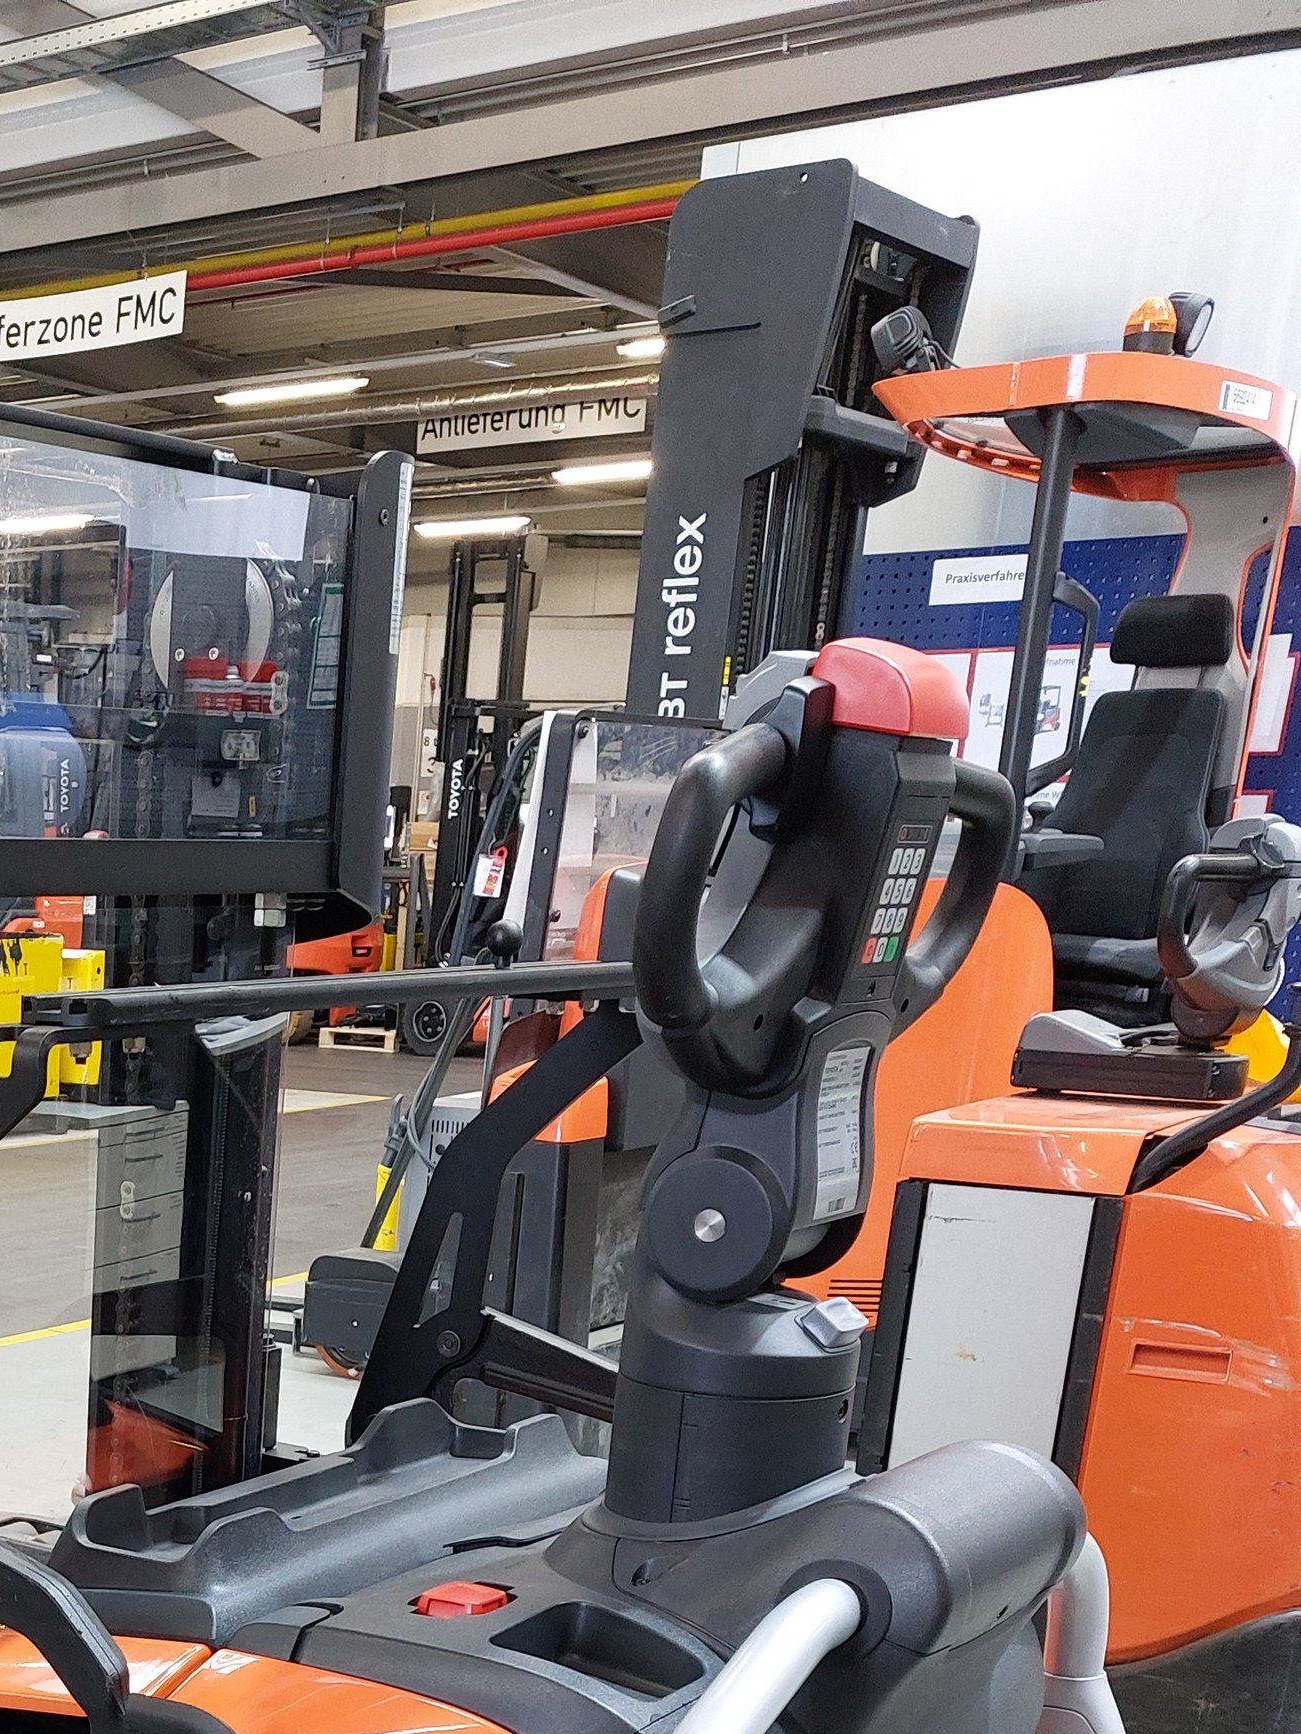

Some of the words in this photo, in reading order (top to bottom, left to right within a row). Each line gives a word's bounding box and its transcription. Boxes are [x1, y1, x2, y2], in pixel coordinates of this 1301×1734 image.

[116, 287, 177, 333] FMC
[662, 512, 707, 655] reflex
[60, 759, 70, 812] TOYOTA
[448, 759, 464, 820] TOYOTA
[904, 854, 911, 869] 2
[915, 854, 922, 869] 3
[885, 884, 892, 899] 4
[895, 884, 902, 899] 5
[907, 883, 913, 898] 6
[875, 914, 883, 929] 7
[886, 913, 893, 928] 8
[897, 913, 904, 928] 9
[877, 942, 885, 957] 0
